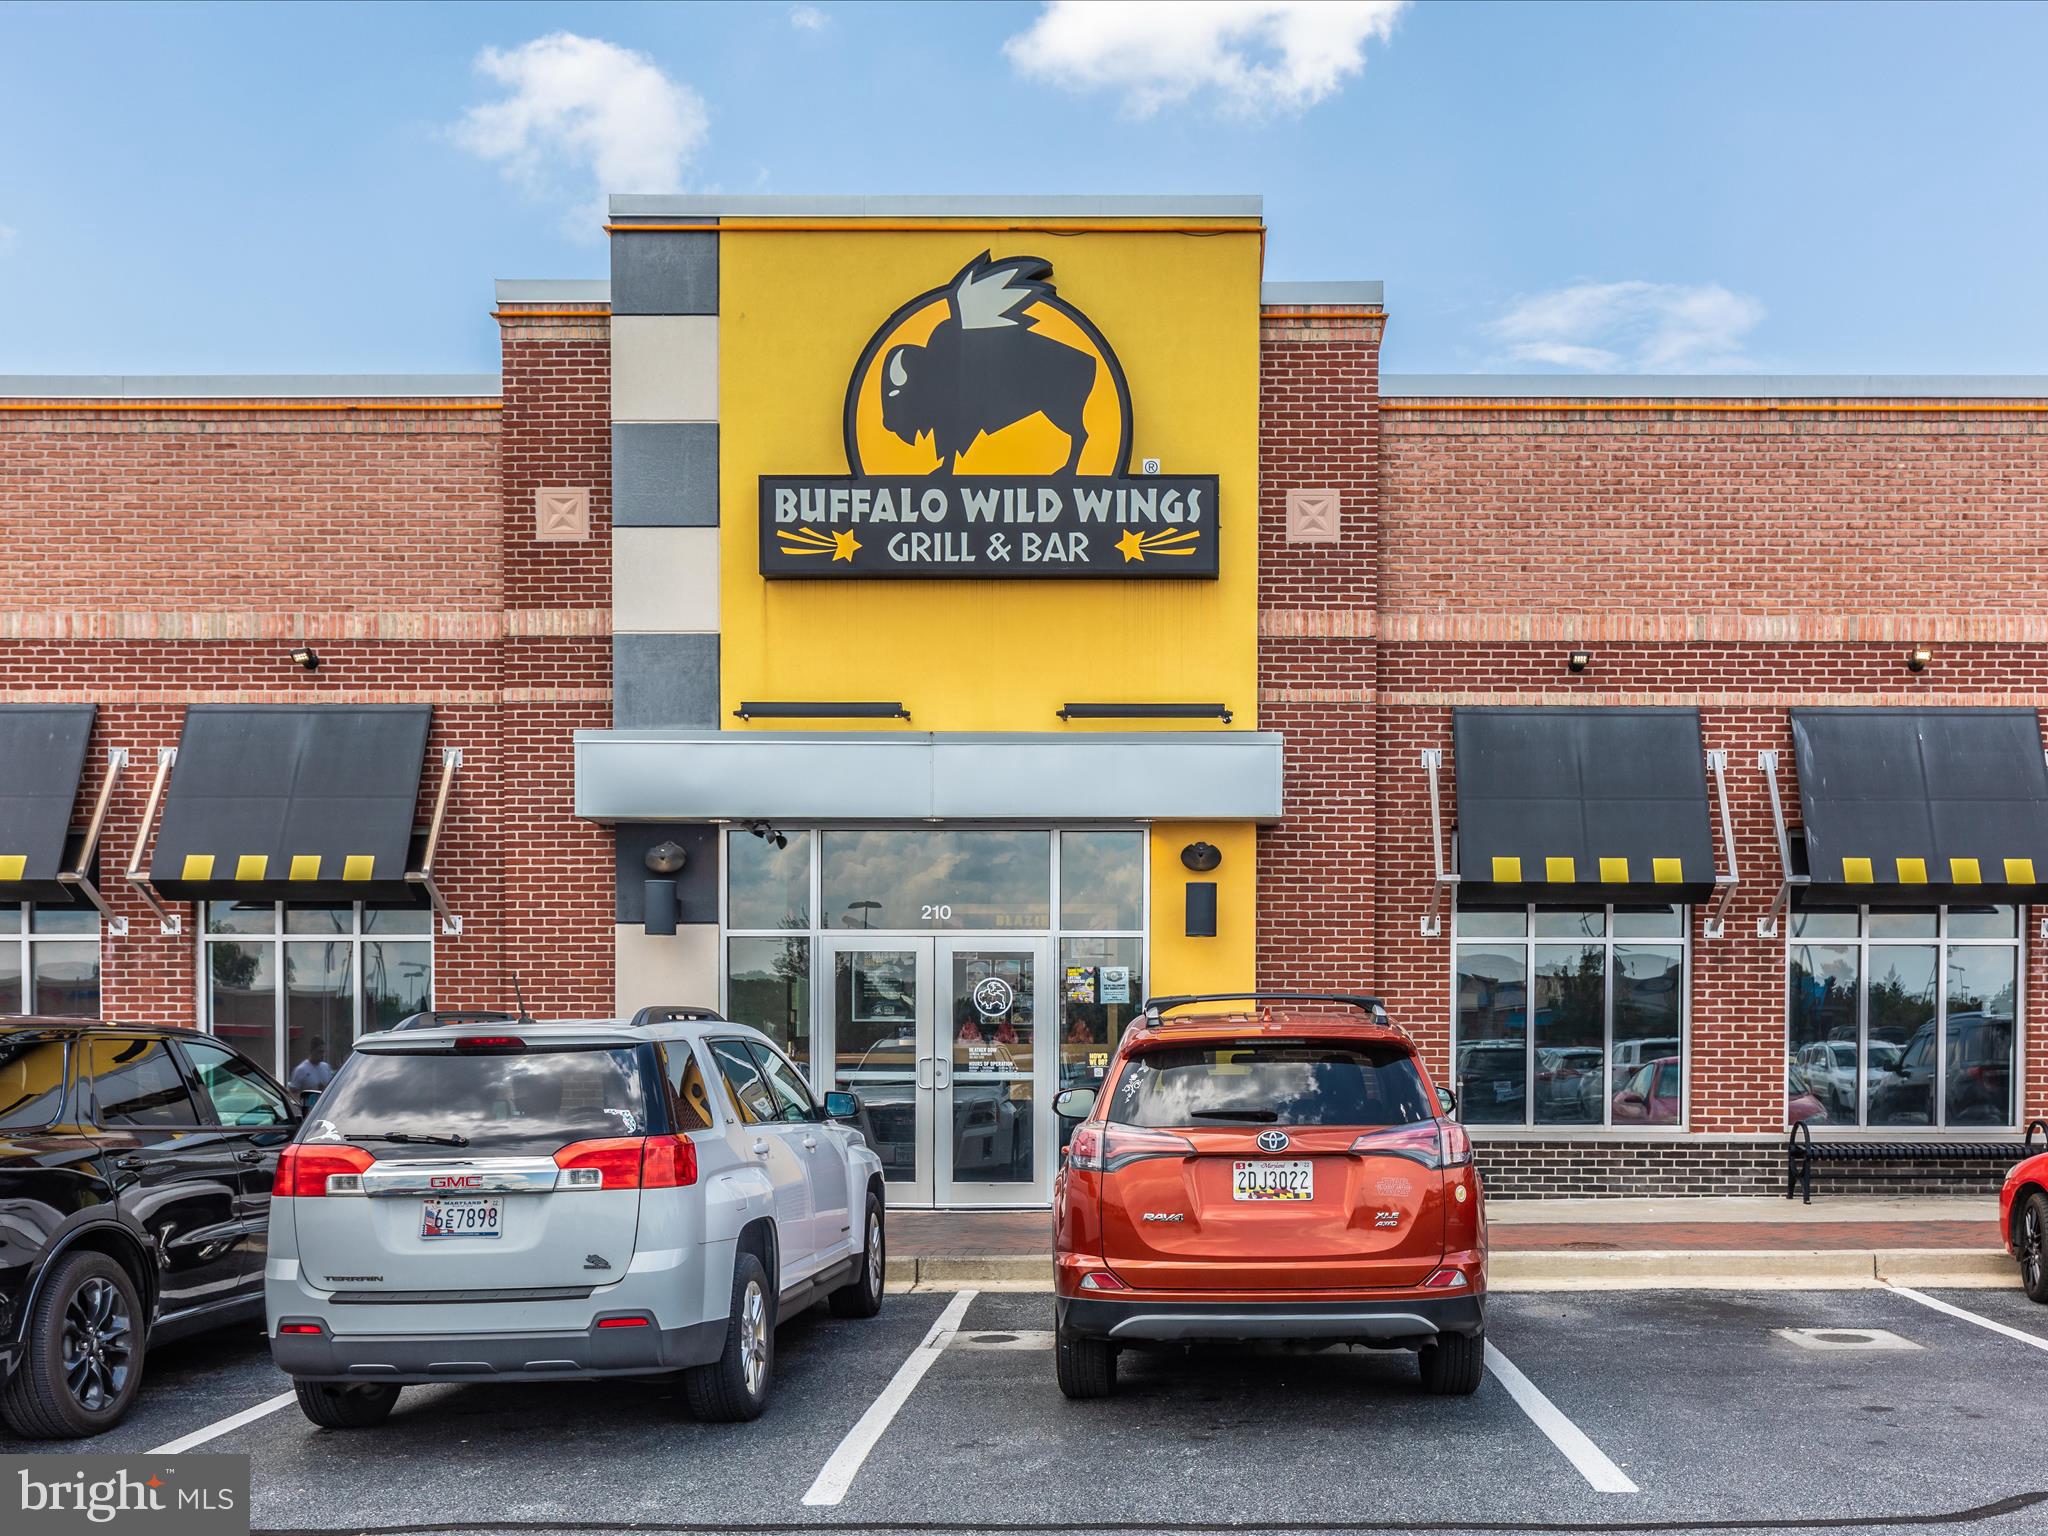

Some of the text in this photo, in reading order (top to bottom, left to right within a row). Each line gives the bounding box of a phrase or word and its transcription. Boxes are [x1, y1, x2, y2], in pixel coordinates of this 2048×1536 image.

[775, 487, 1202, 523] BUFFALO WILD WINGS
[887, 531, 1089, 562] GRILL & BAR
[921, 904, 952, 920] 210
[430, 1175, 483, 1188] GMC
[1238, 1171, 1309, 1190] 2DJ3022
[1142, 1212, 1184, 1222] RAV4
[1375, 1211, 1400, 1220] XLE
